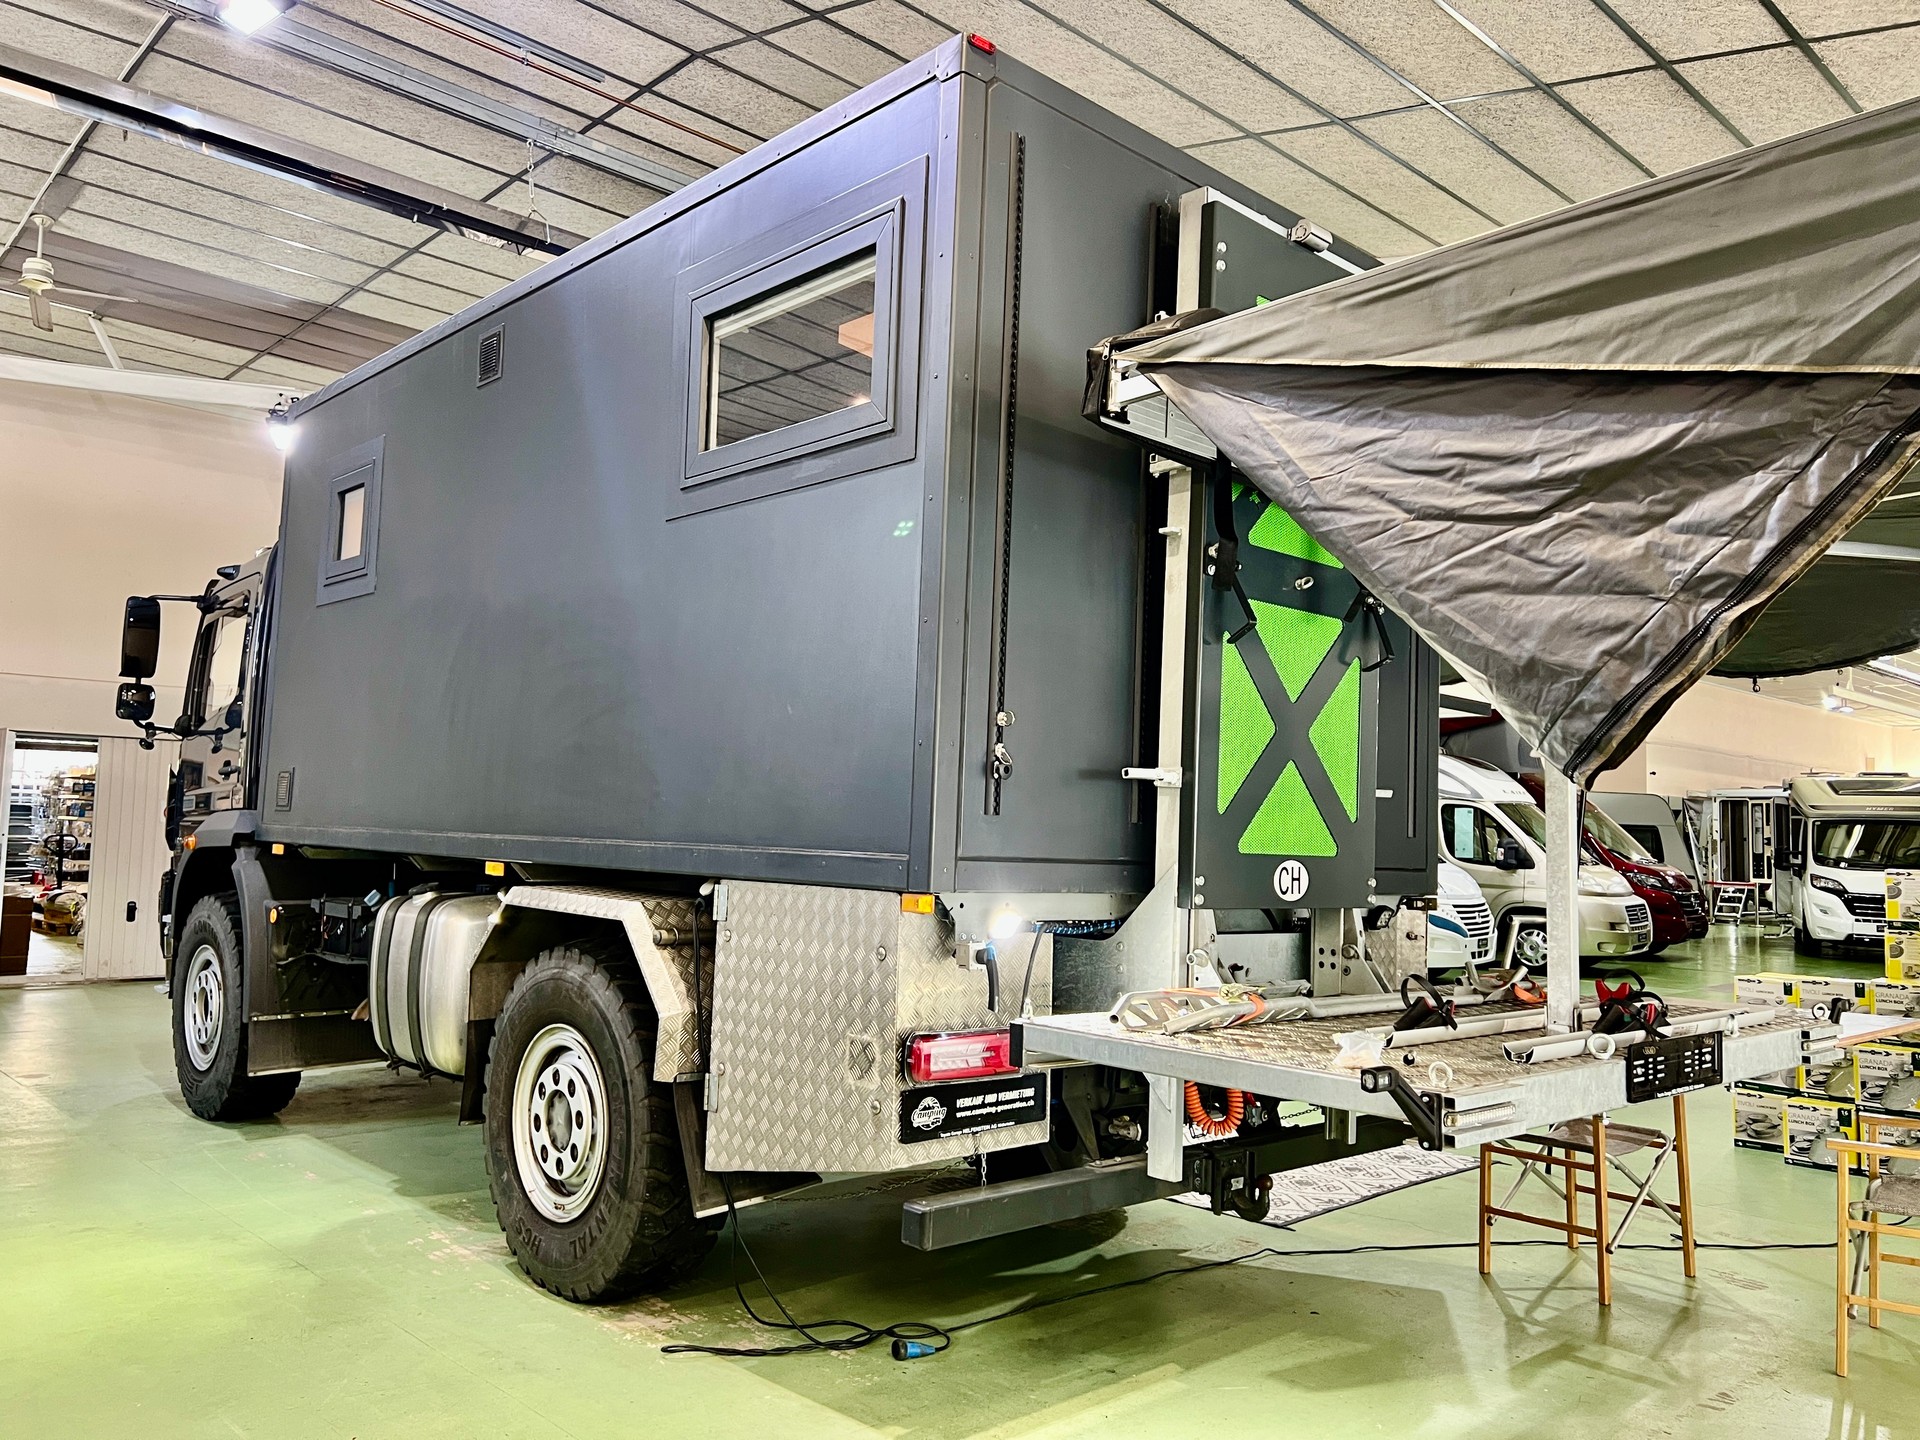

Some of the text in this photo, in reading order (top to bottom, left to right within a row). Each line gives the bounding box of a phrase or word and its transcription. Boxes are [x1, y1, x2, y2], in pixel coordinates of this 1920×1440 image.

[1278, 866, 1301, 895] CH
[1875, 991, 1910, 1000] GRANADA
[1858, 1058, 1894, 1067] GRANADA
[956, 1087, 1036, 1109] VERKAUF UND VERMIETUNG
[1787, 1112, 1821, 1122] GRANADA
[1865, 1123, 1900, 1133] GNADA
